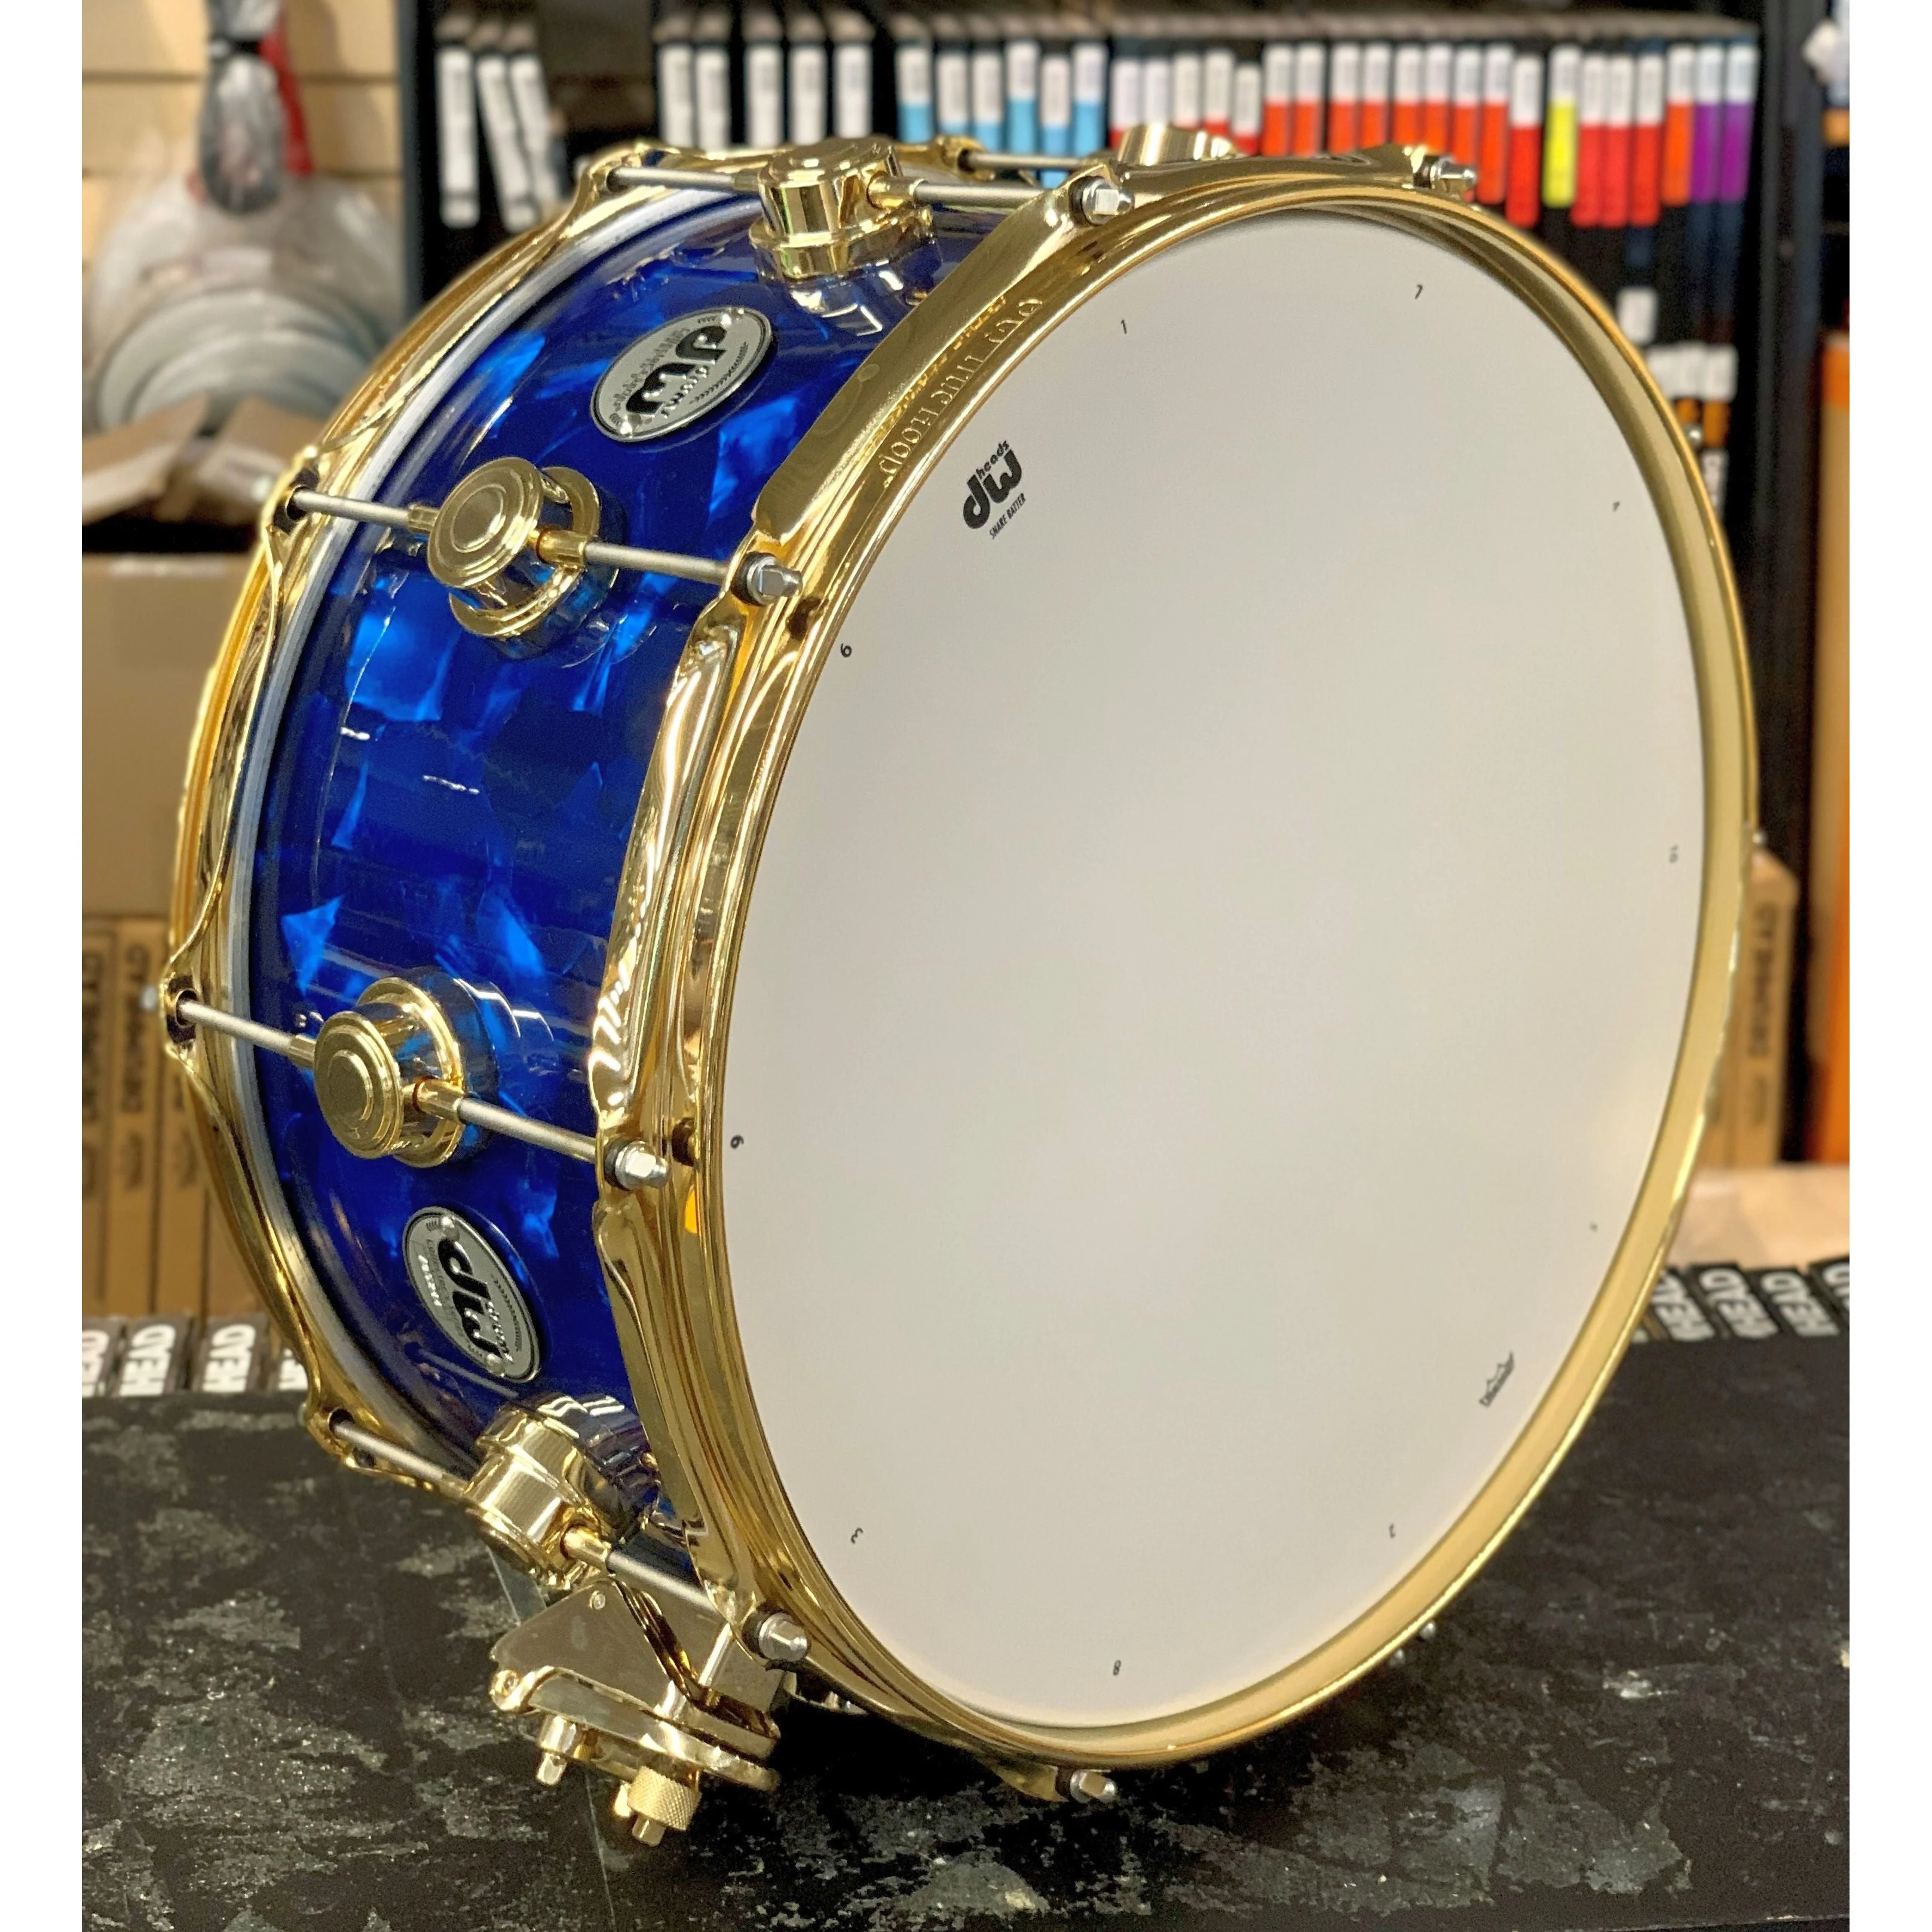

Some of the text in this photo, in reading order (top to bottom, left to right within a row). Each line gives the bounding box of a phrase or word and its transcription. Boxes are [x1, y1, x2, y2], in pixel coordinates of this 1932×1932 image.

[976, 440, 1009, 479] heads
[963, 449, 1022, 529] dw
[989, 492, 1026, 540] SNARE BATTER
[203, 1324, 256, 1392] HEAD
